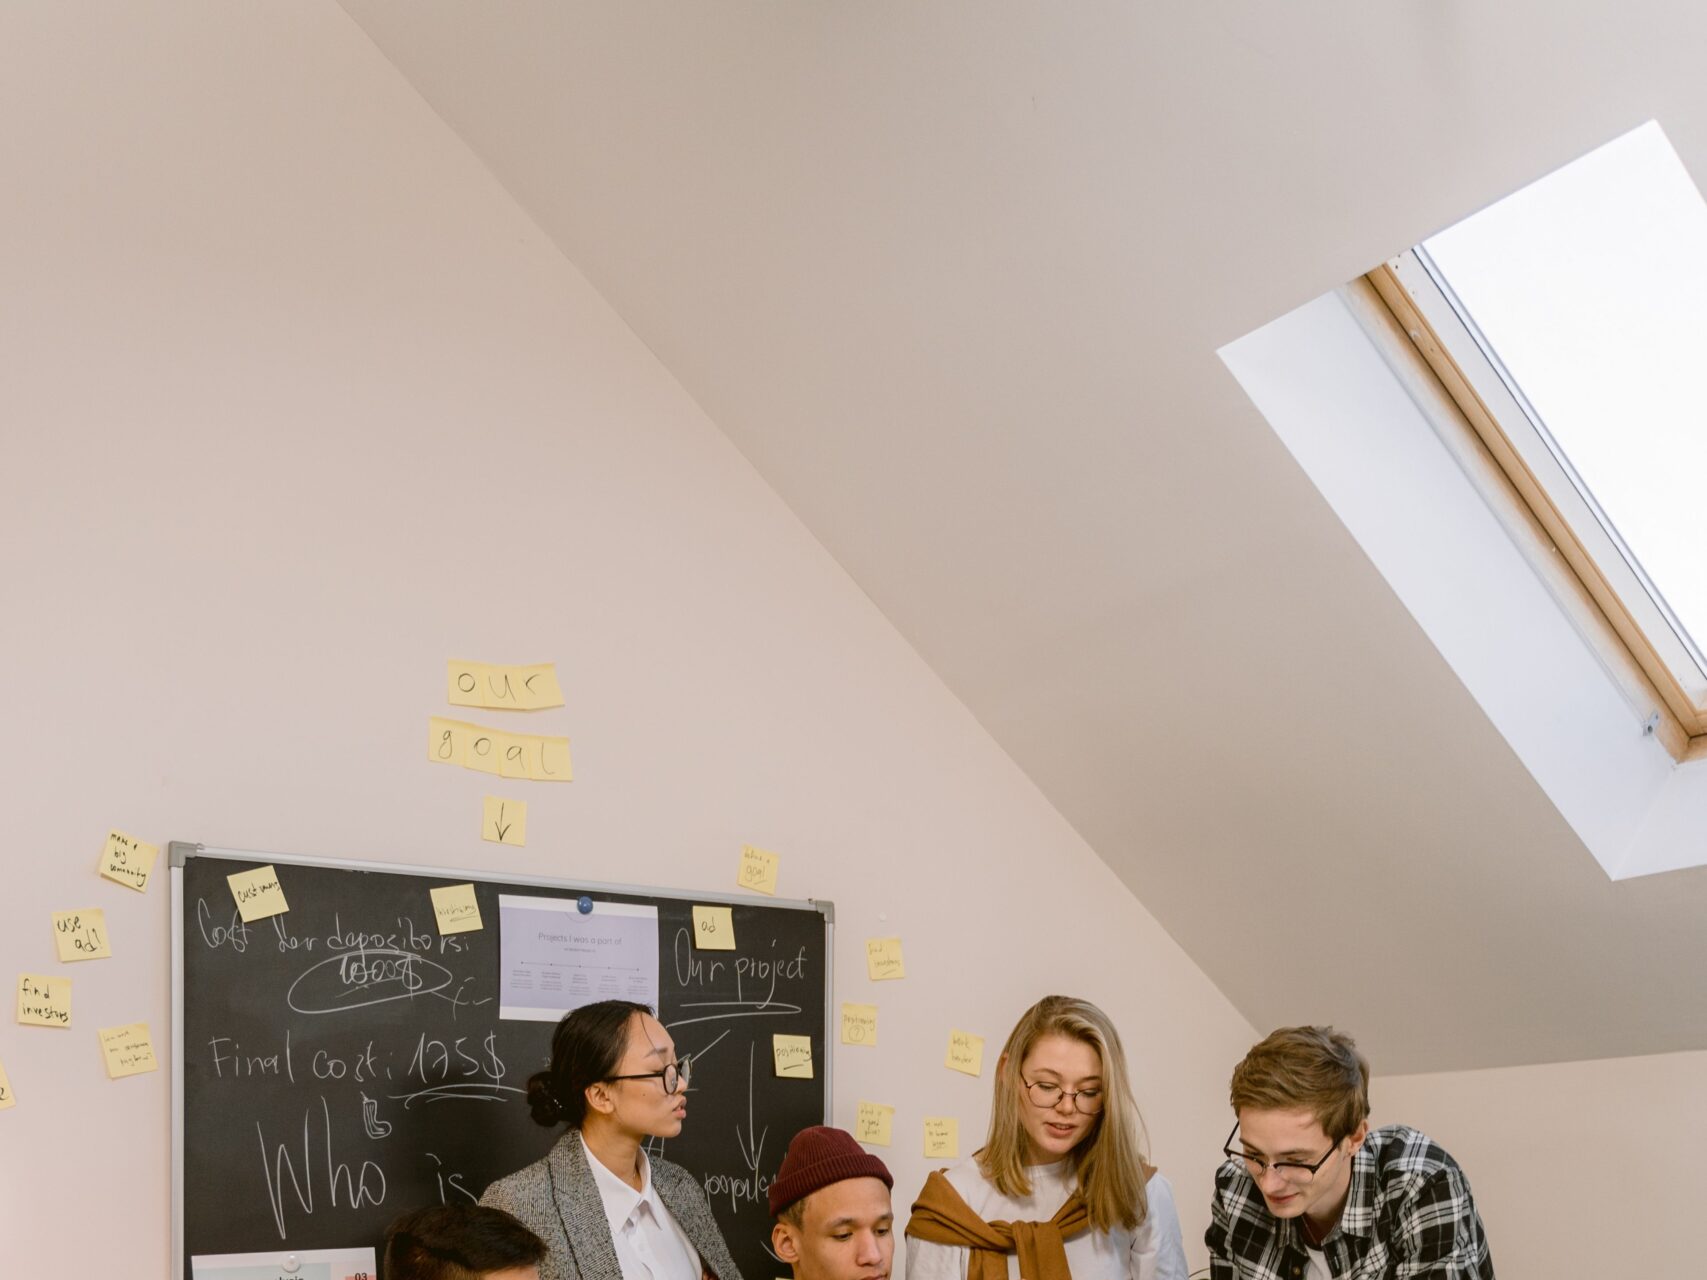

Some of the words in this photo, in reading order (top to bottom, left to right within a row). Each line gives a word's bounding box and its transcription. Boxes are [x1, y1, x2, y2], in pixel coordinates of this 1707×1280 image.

[438, 729, 557, 775] goal
[57, 915, 81, 933] use
[22, 977, 50, 999] find
[675, 927, 725, 987] Our
[734, 938, 807, 1011] project
[22, 1002, 69, 1023] investors
[208, 1029, 295, 1084] Final
[256, 1095, 386, 1240] Who
